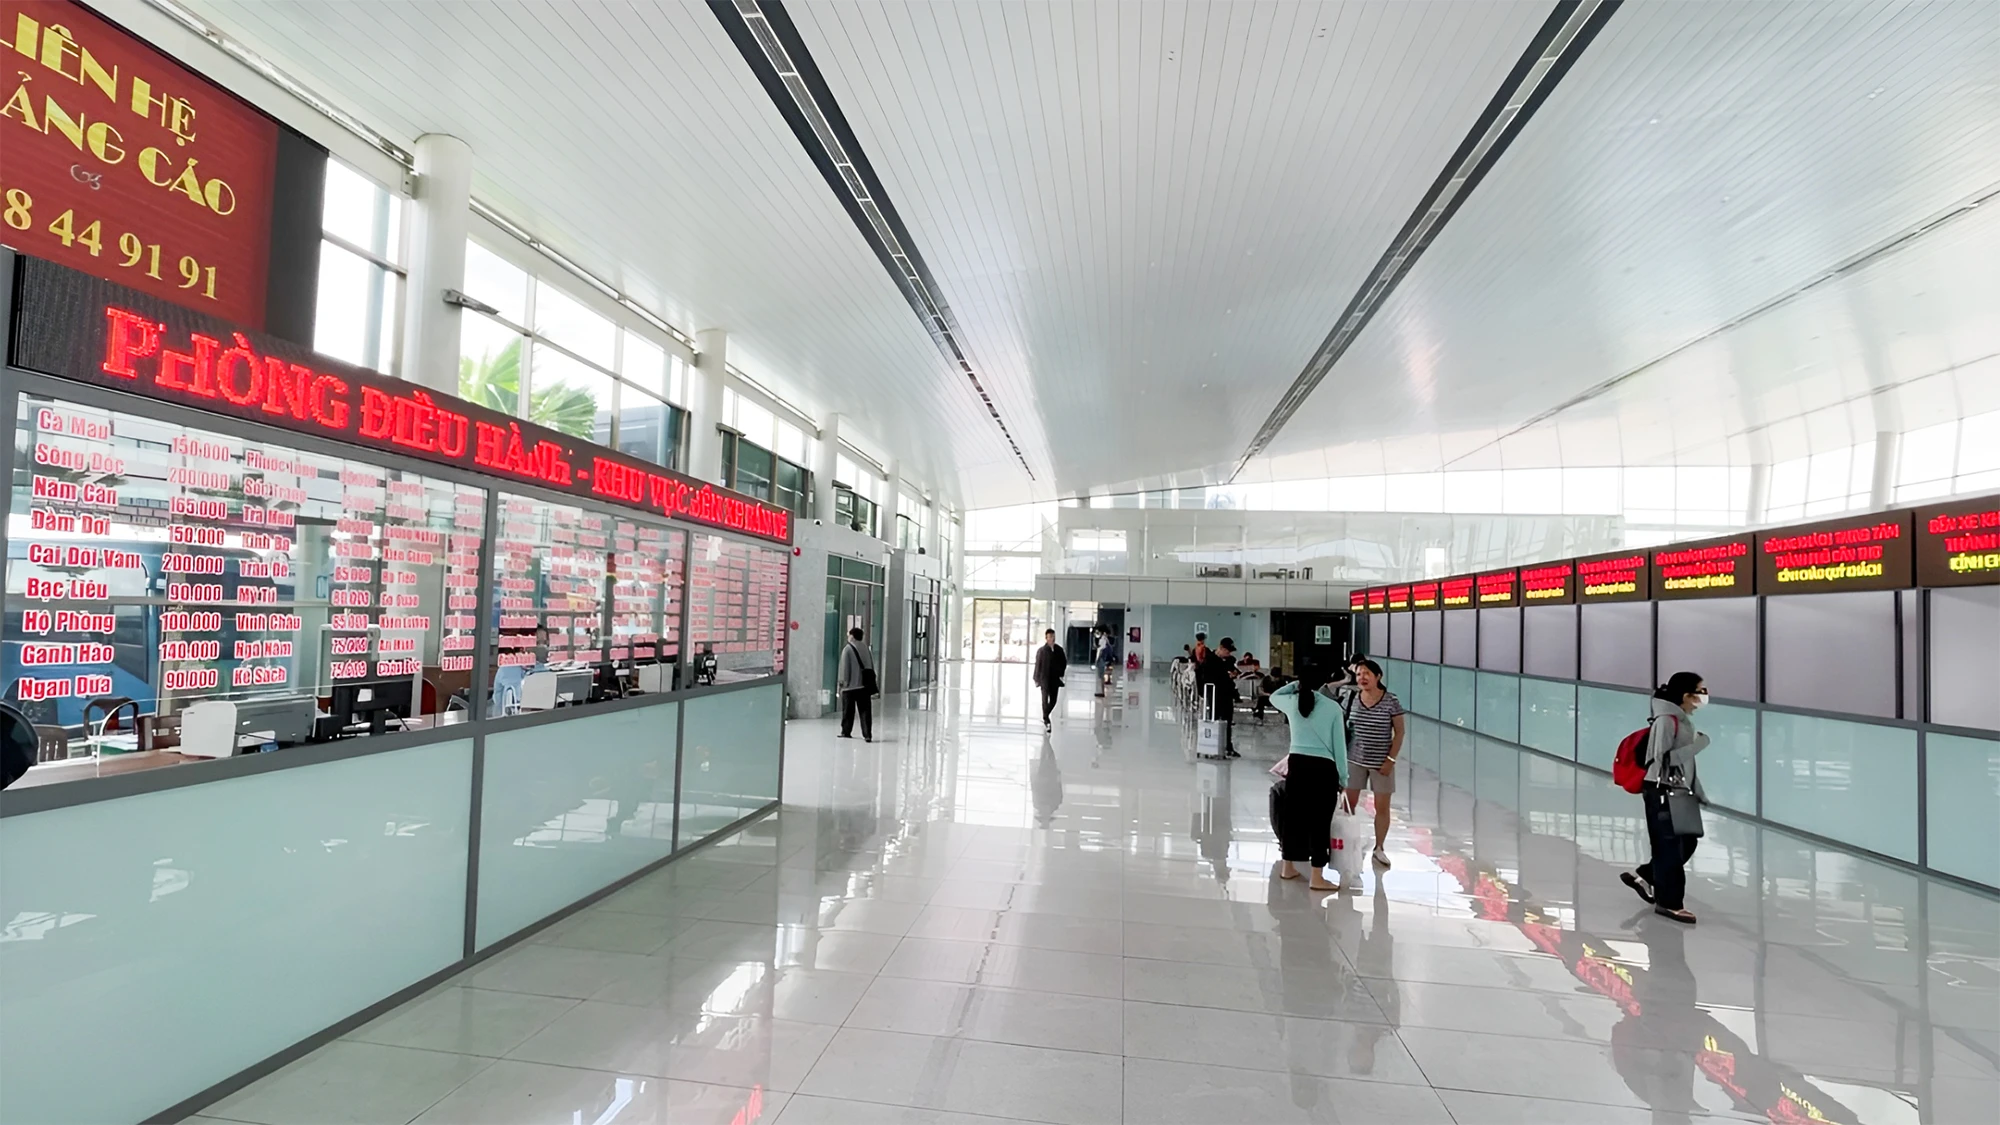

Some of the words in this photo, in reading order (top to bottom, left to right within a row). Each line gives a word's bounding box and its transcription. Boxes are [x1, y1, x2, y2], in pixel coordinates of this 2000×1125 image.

[0, 12, 118, 103] IÊN
[132, 76, 197, 147] HỆ
[0, 187, 33, 231] 8
[48, 209, 103, 257] 44
[119, 232, 163, 281] 91
[178, 256, 218, 300] 91
[71, 416, 109, 440] Mau
[359, 385, 470, 458] ĐIỀU
[591, 455, 647, 503] KHU
[170, 496, 227, 520] 165.000
[1958, 514, 1979, 530] XE
[168, 525, 225, 546] 150.000
[162, 554, 224, 574] 200.000
[169, 583, 222, 601] 90.000
[160, 612, 221, 632] 100.000
[159, 641, 219, 661] 140.000
[20, 679, 70, 701] Ngan
[166, 670, 217, 690] 90.000
